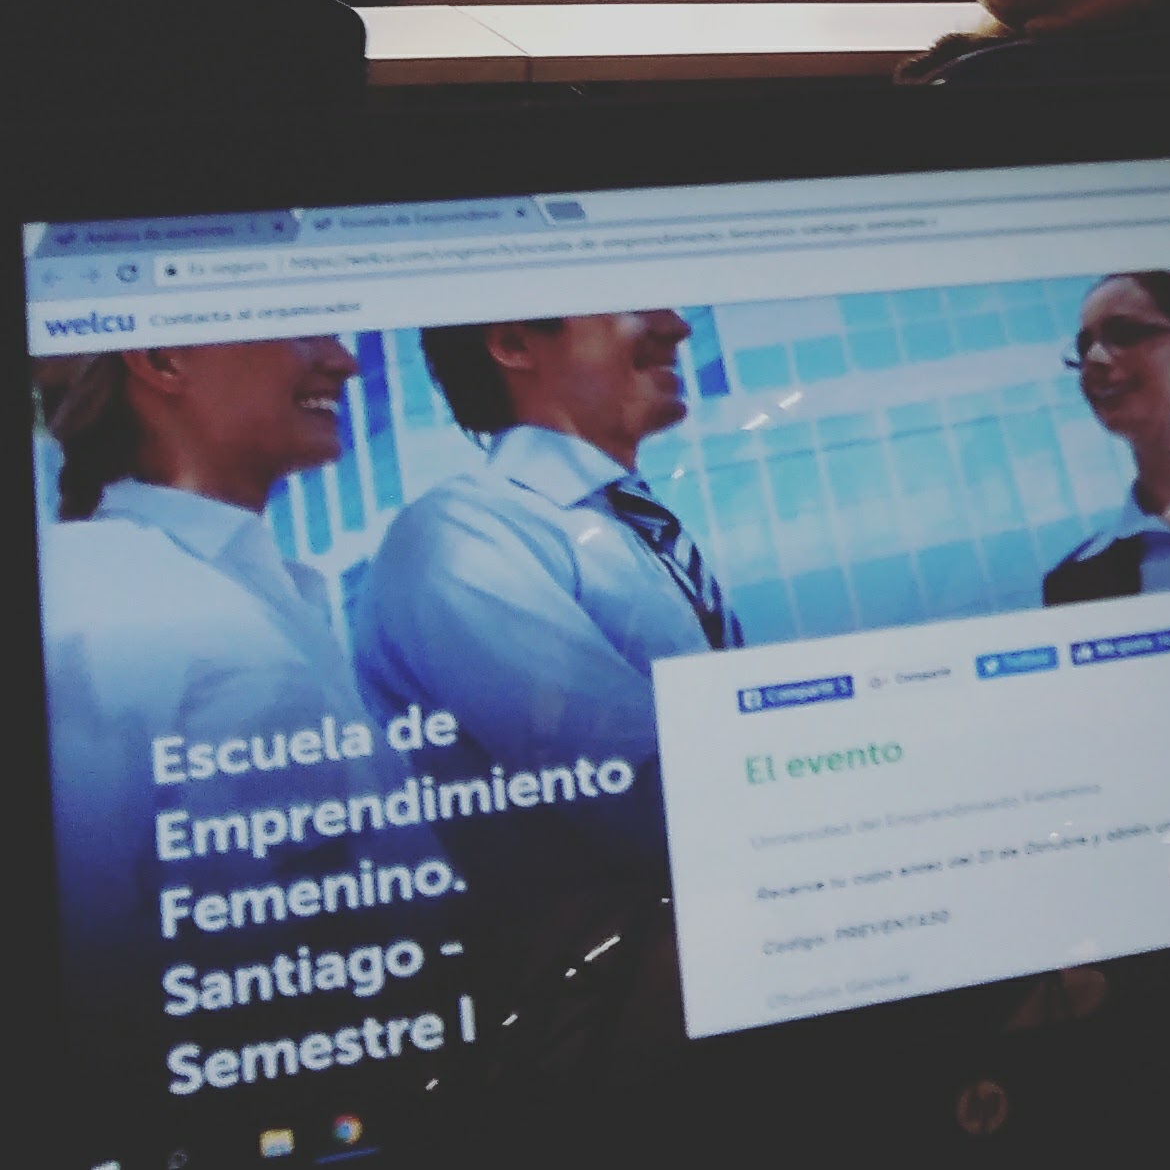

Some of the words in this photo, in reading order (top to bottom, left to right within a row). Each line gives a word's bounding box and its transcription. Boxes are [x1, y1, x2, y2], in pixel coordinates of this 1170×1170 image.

[45, 310, 136, 337] welcu
[151, 715, 373, 784] Escuela
[386, 704, 458, 752] de
[746, 754, 776, 785] El
[786, 741, 905, 779] evento
[155, 757, 635, 862] Emprendimiento
[160, 858, 467, 939] Femenino.
[162, 939, 425, 1017] Santiago
[166, 1011, 445, 1096] Semestre
